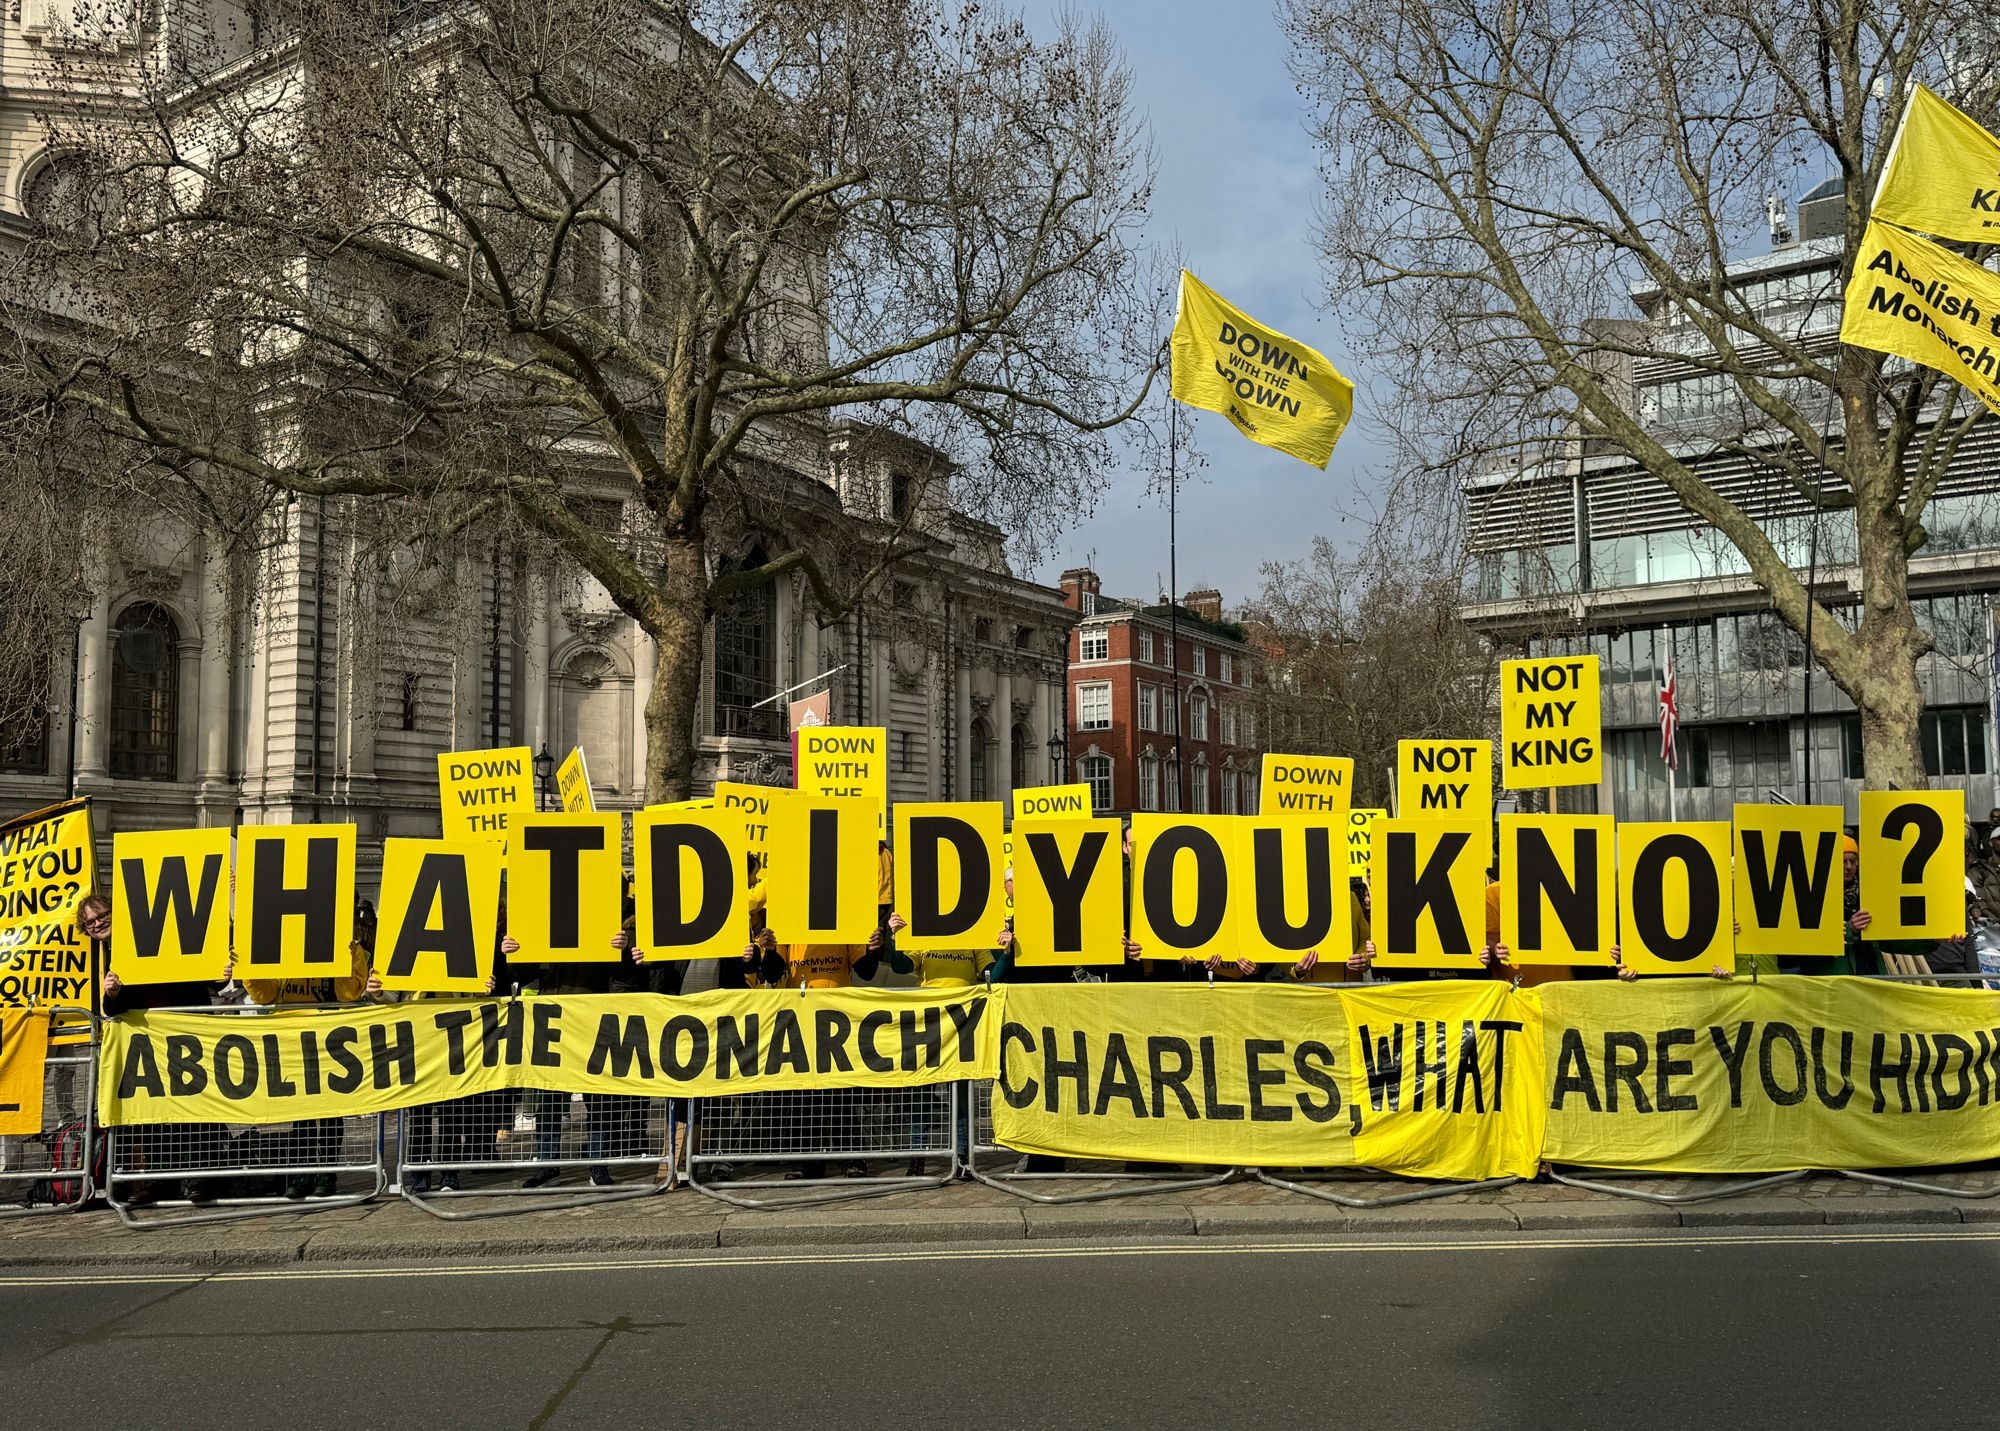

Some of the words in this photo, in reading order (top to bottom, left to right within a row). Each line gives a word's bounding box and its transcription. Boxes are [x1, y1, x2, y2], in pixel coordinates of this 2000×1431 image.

[1867, 249, 1981, 327] Abolish
[1219, 321, 1308, 381] DOWN
[1229, 352, 1260, 378] WITH
[1264, 371, 1290, 391] THE
[1234, 409, 1258, 433] Republic
[1516, 663, 1584, 693] NOT
[1526, 701, 1577, 729] MY
[808, 737, 875, 754] DOWN
[1511, 737, 1594, 768] KING
[450, 759, 521, 781] DOWN
[814, 762, 869, 779] WITH
[1413, 747, 1477, 773] NOT
[561, 763, 580, 797] DOWN
[1273, 766, 1342, 786] DOWN
[458, 786, 517, 807] WITH
[725, 794, 769, 815] DOW
[1022, 795, 1083, 815] DOWN
[1278, 791, 1333, 811] WITH
[1420, 783, 1470, 809] MY
[466, 813, 508, 832] THE
[22, 847, 82, 883] YOU
[0, 976, 90, 1003] QUIRY
[117, 1020, 416, 1100] ABOLISH
[435, 1001, 563, 1075] THE
[587, 999, 987, 1081] MONARCHY
[999, 1022, 1363, 1137] CHARLES,
[1359, 1019, 1524, 1114] WHAT
[1551, 1028, 1698, 1113] ARE
[1709, 1020, 1855, 1110] YOU
